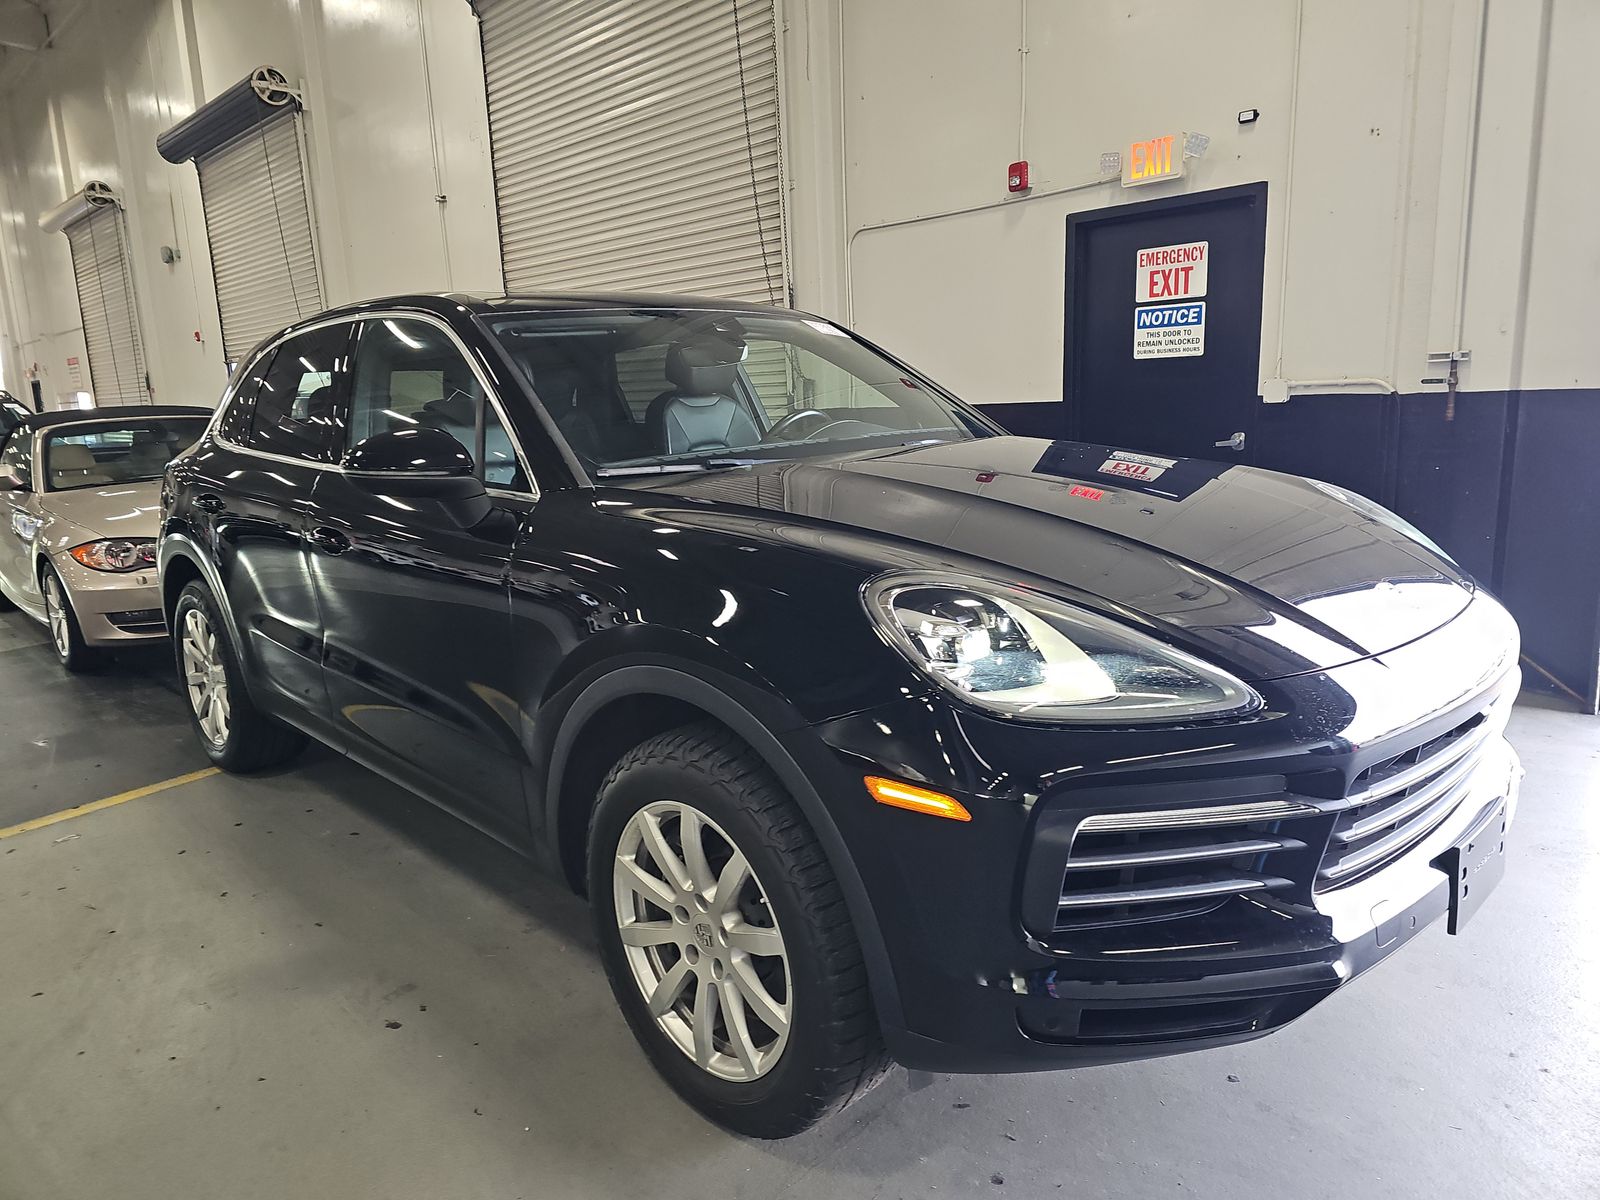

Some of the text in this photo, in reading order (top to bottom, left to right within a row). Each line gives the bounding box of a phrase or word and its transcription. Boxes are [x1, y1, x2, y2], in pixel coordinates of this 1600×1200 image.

[1131, 135, 1175, 180] EXIT
[1139, 245, 1206, 267] EMERGENCY
[1149, 266, 1194, 298] EXIT
[1140, 308, 1200, 326] NOTICE
[1137, 337, 1201, 348] REMAIN UNLOCKED
[1146, 331, 1161, 339] THIS
